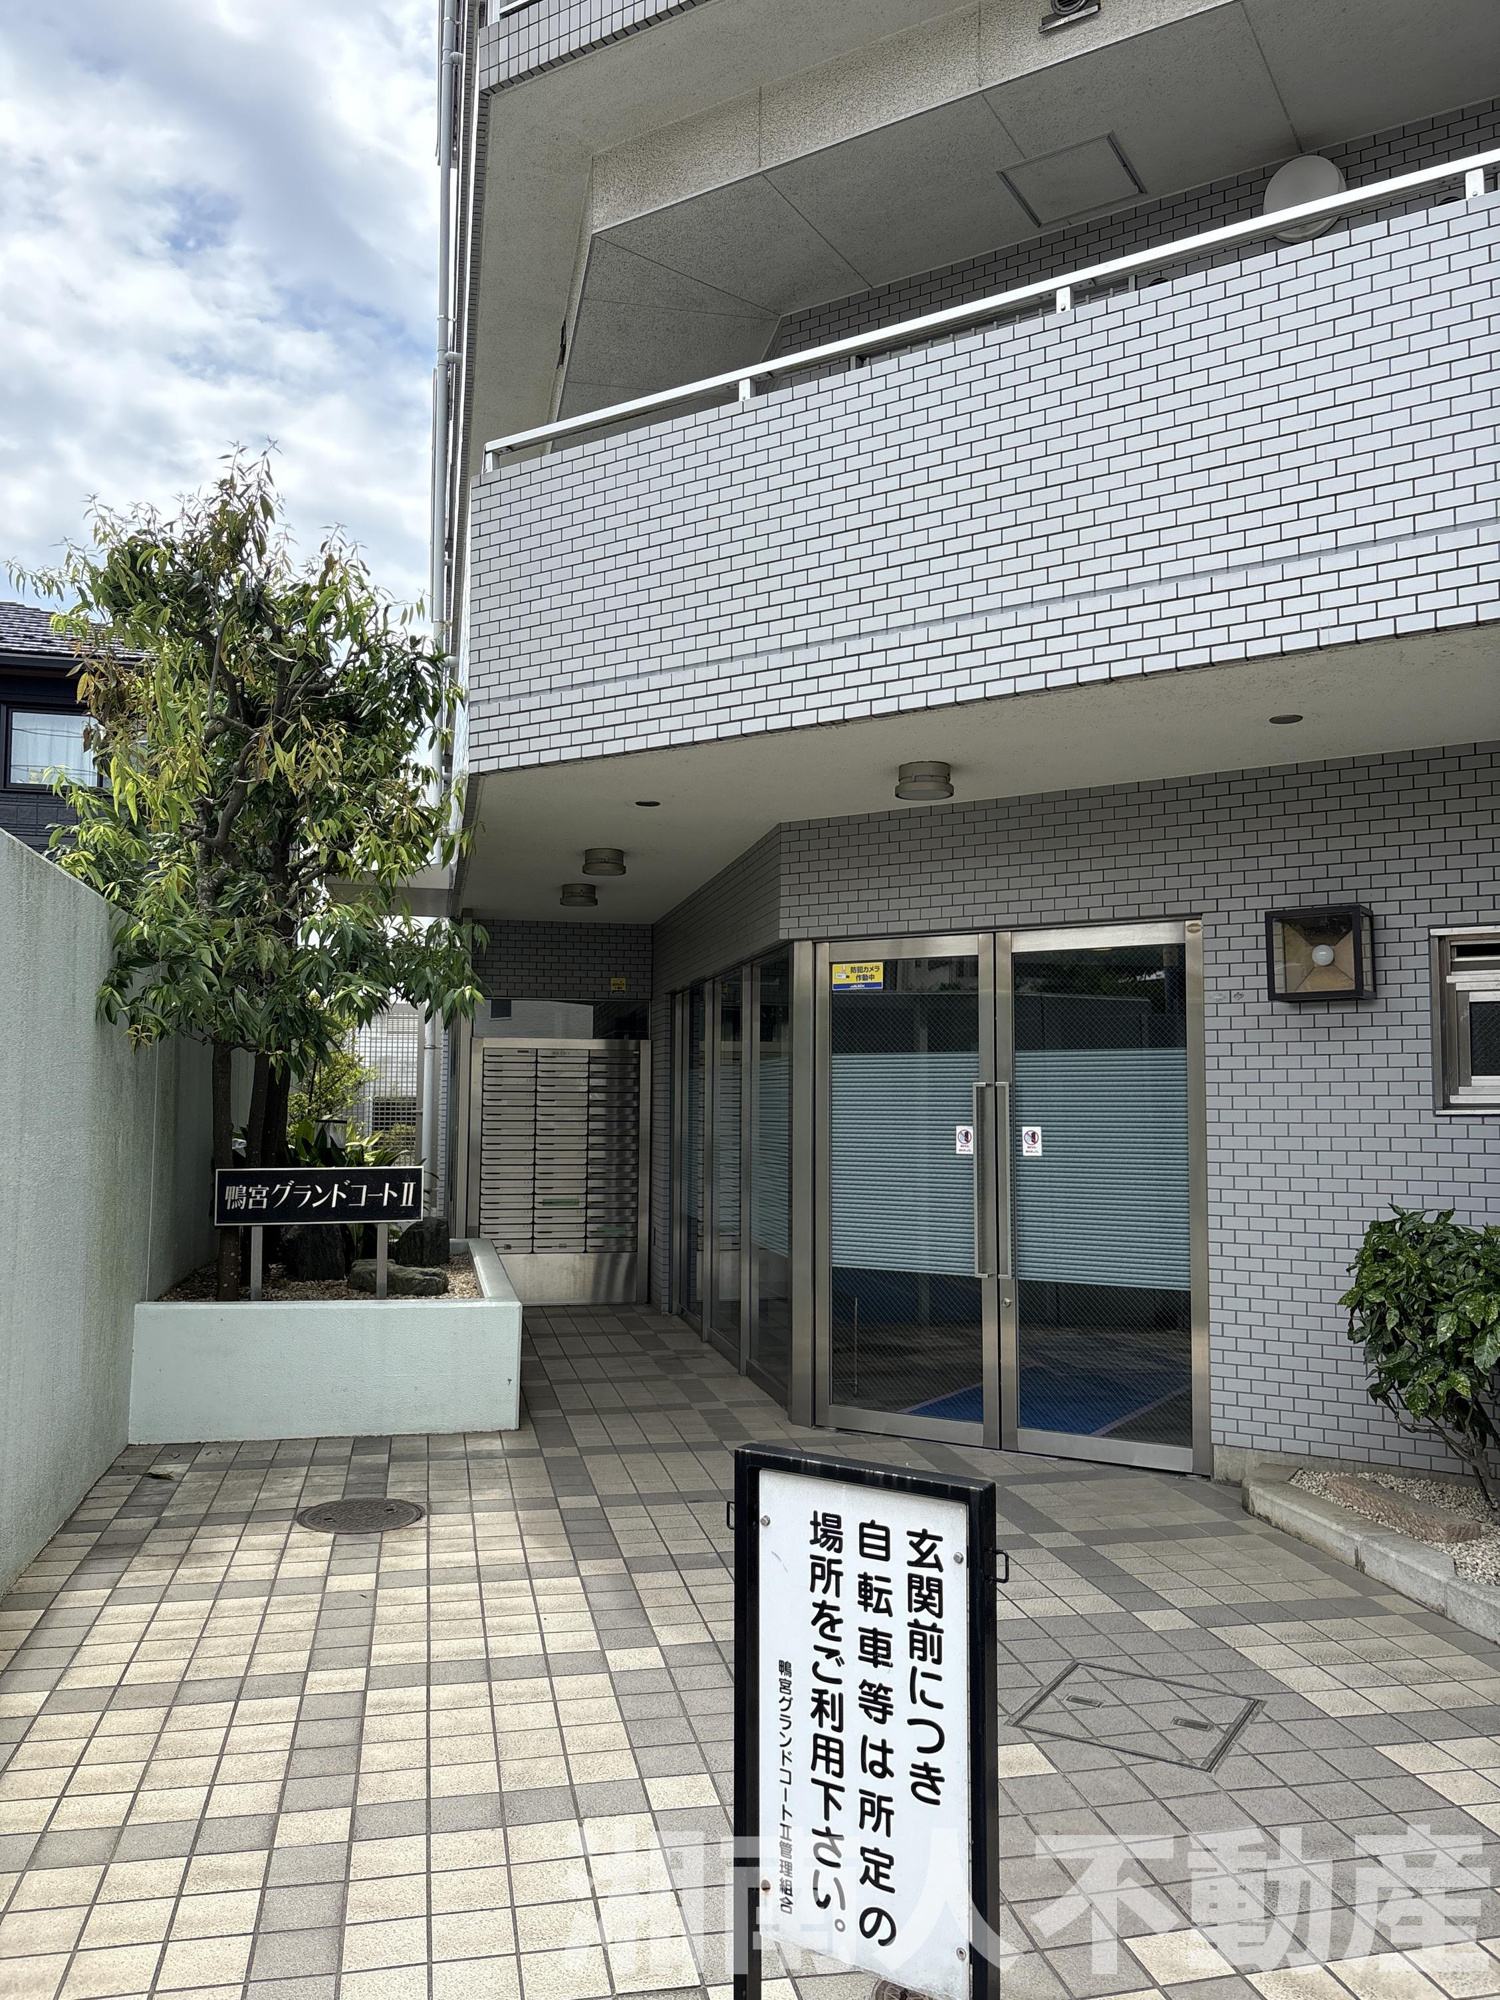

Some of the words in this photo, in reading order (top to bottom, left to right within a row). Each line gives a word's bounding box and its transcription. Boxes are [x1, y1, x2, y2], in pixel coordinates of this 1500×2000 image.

[850, 966, 881, 974] 防犯カメラ
[856, 974, 876, 982] 作動中
[224, 1179, 417, 1210] 鴨宮グランドコートⅡ
[809, 1510, 846, 1934] 場所をご利用下さい。
[857, 1519, 898, 1947] 自転車等は所定の
[906, 1528, 946, 1807] 玄関前につき
